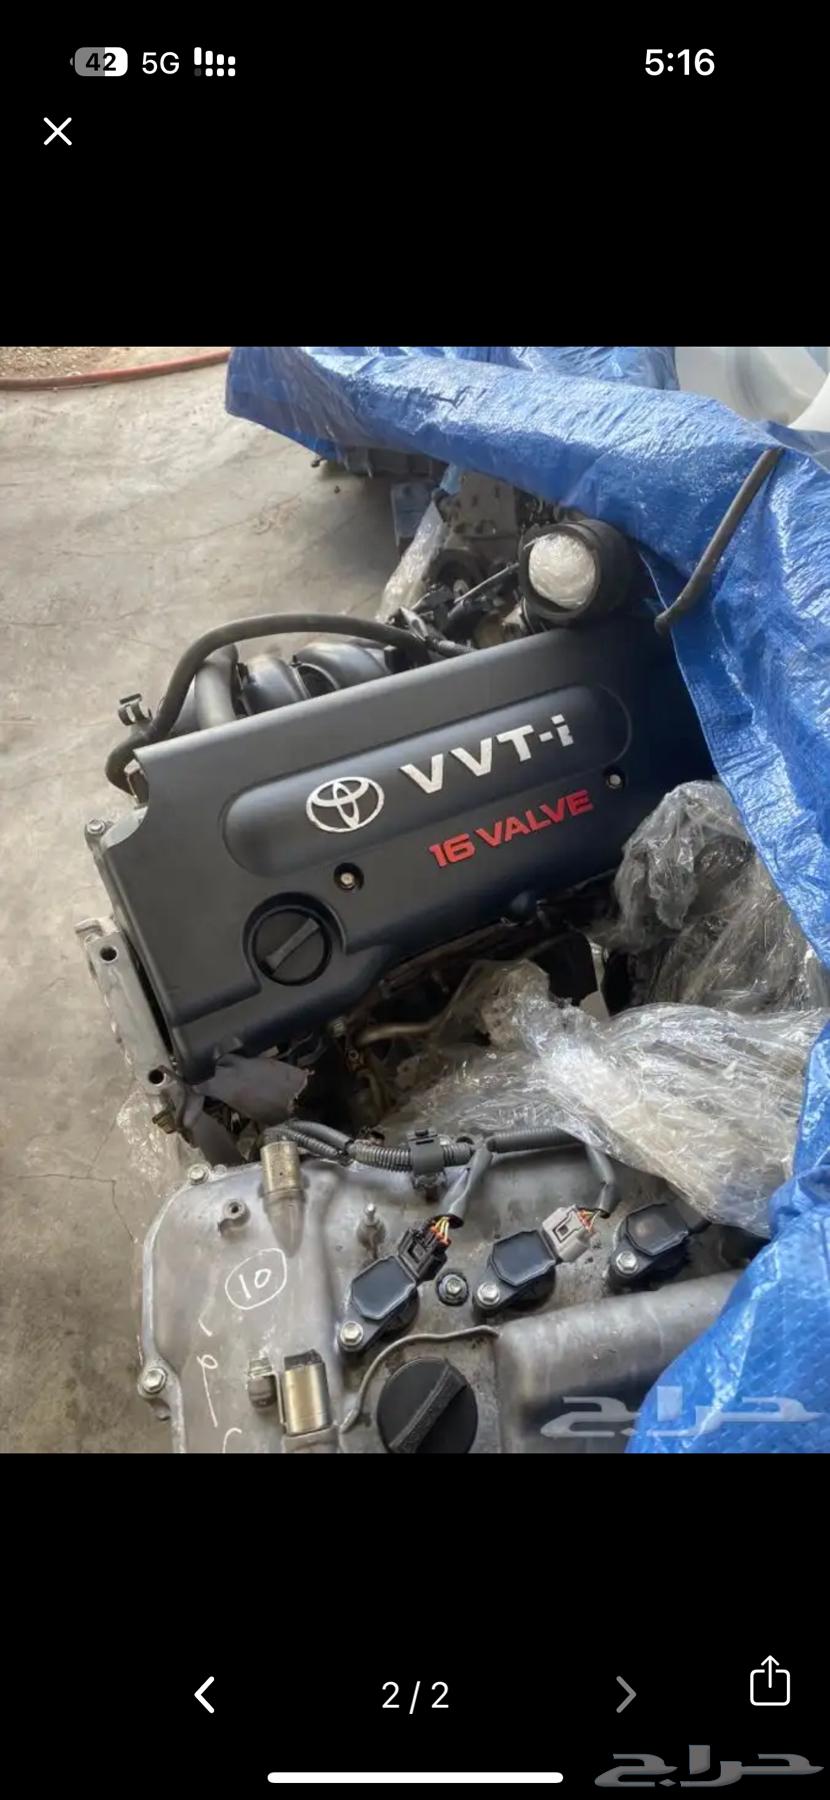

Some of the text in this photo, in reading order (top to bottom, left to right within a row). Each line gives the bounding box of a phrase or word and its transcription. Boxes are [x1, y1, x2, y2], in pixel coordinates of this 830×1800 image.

[400, 713, 574, 794] VVT-i
[427, 789, 594, 868] 16 VALVE
[238, 1268, 272, 1300] 10
